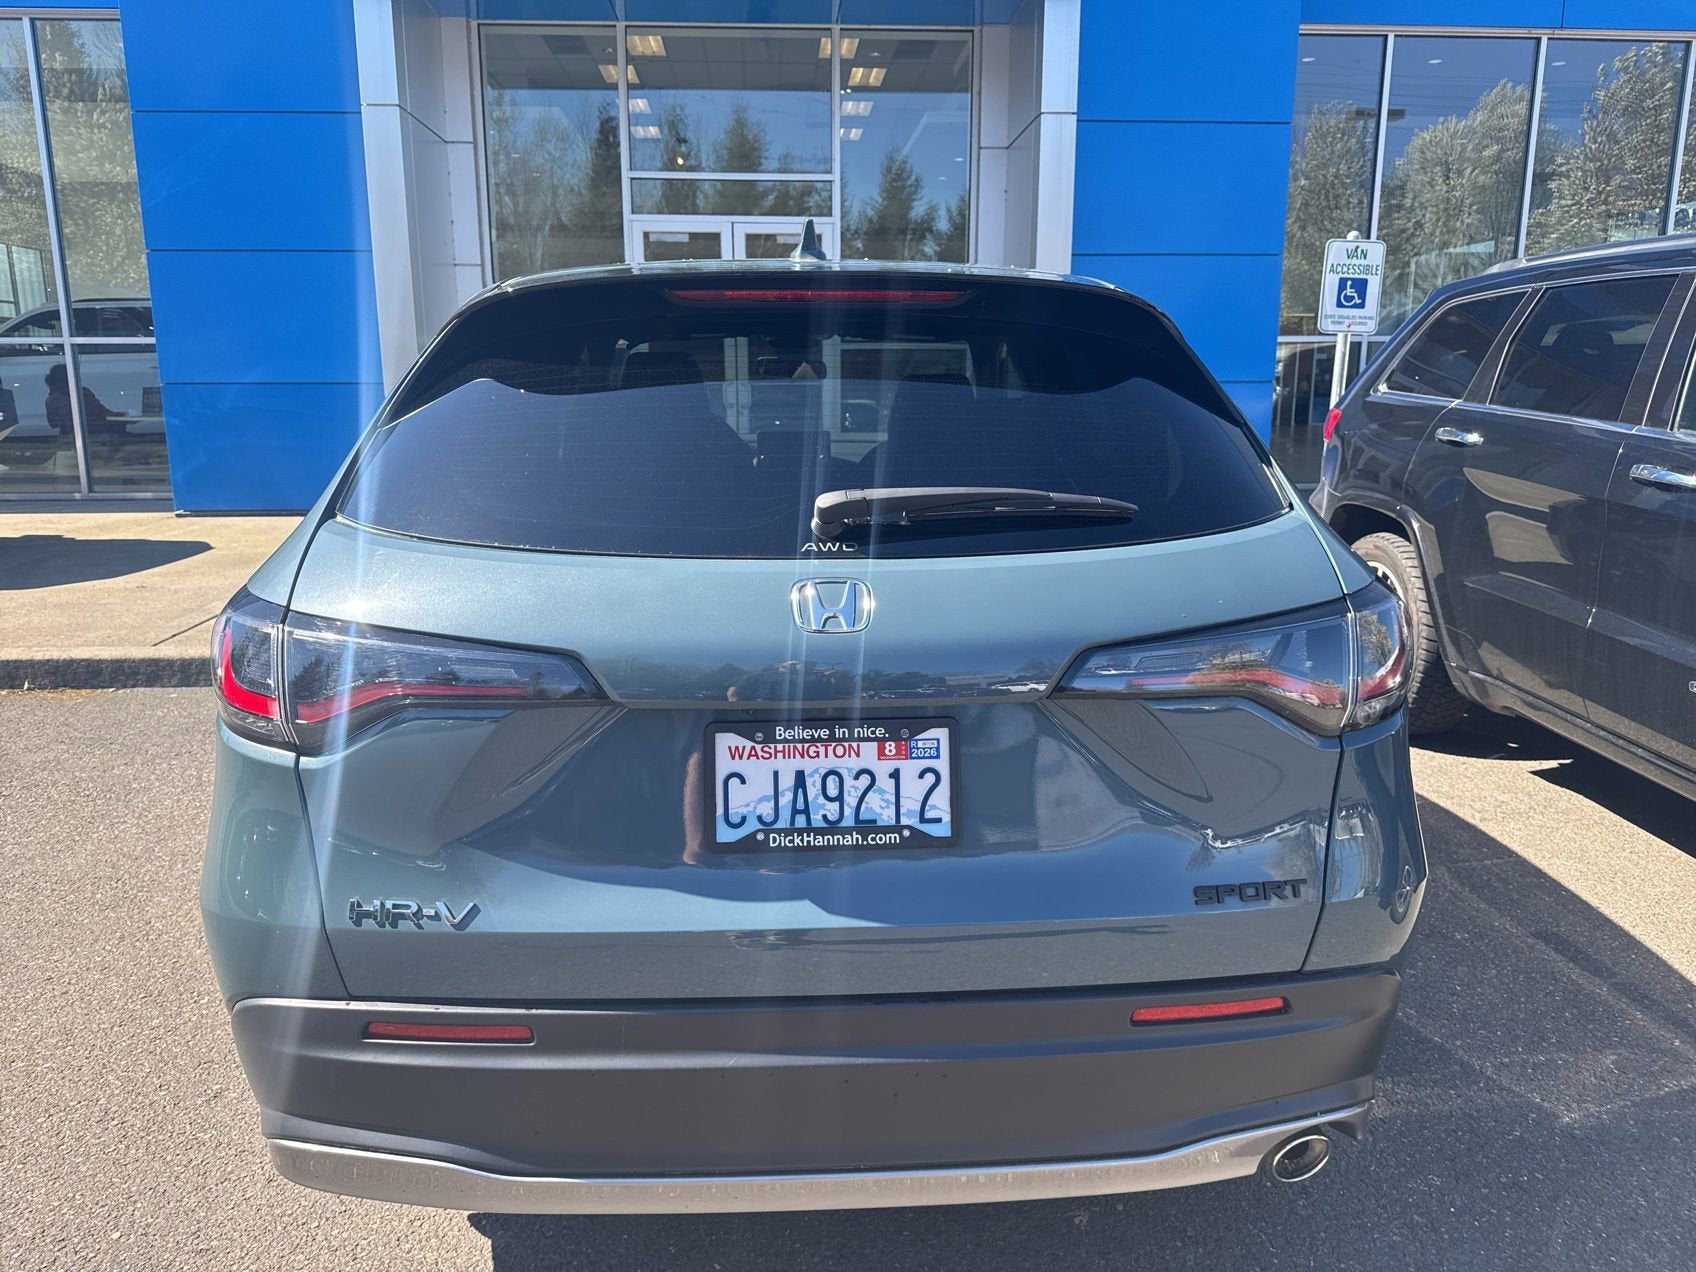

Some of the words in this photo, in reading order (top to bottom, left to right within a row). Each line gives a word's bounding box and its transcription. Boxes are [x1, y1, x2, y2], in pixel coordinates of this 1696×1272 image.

[1346, 248, 1368, 260] VAN
[1329, 263, 1380, 276] ACCESSIBLE
[801, 542, 858, 551] AWD
[775, 726, 829, 740] Believe
[835, 725, 849, 739] in
[854, 725, 889, 738] nice.
[728, 742, 861, 761] WASHINGTON
[884, 741, 897, 756] 8
[911, 740, 918, 748] R
[911, 748, 938, 757] 2026
[723, 766, 943, 829] CJA9212
[769, 832, 900, 847] DickHannah.com
[1193, 879, 1308, 905] SPORT
[349, 897, 482, 932] HR-V
